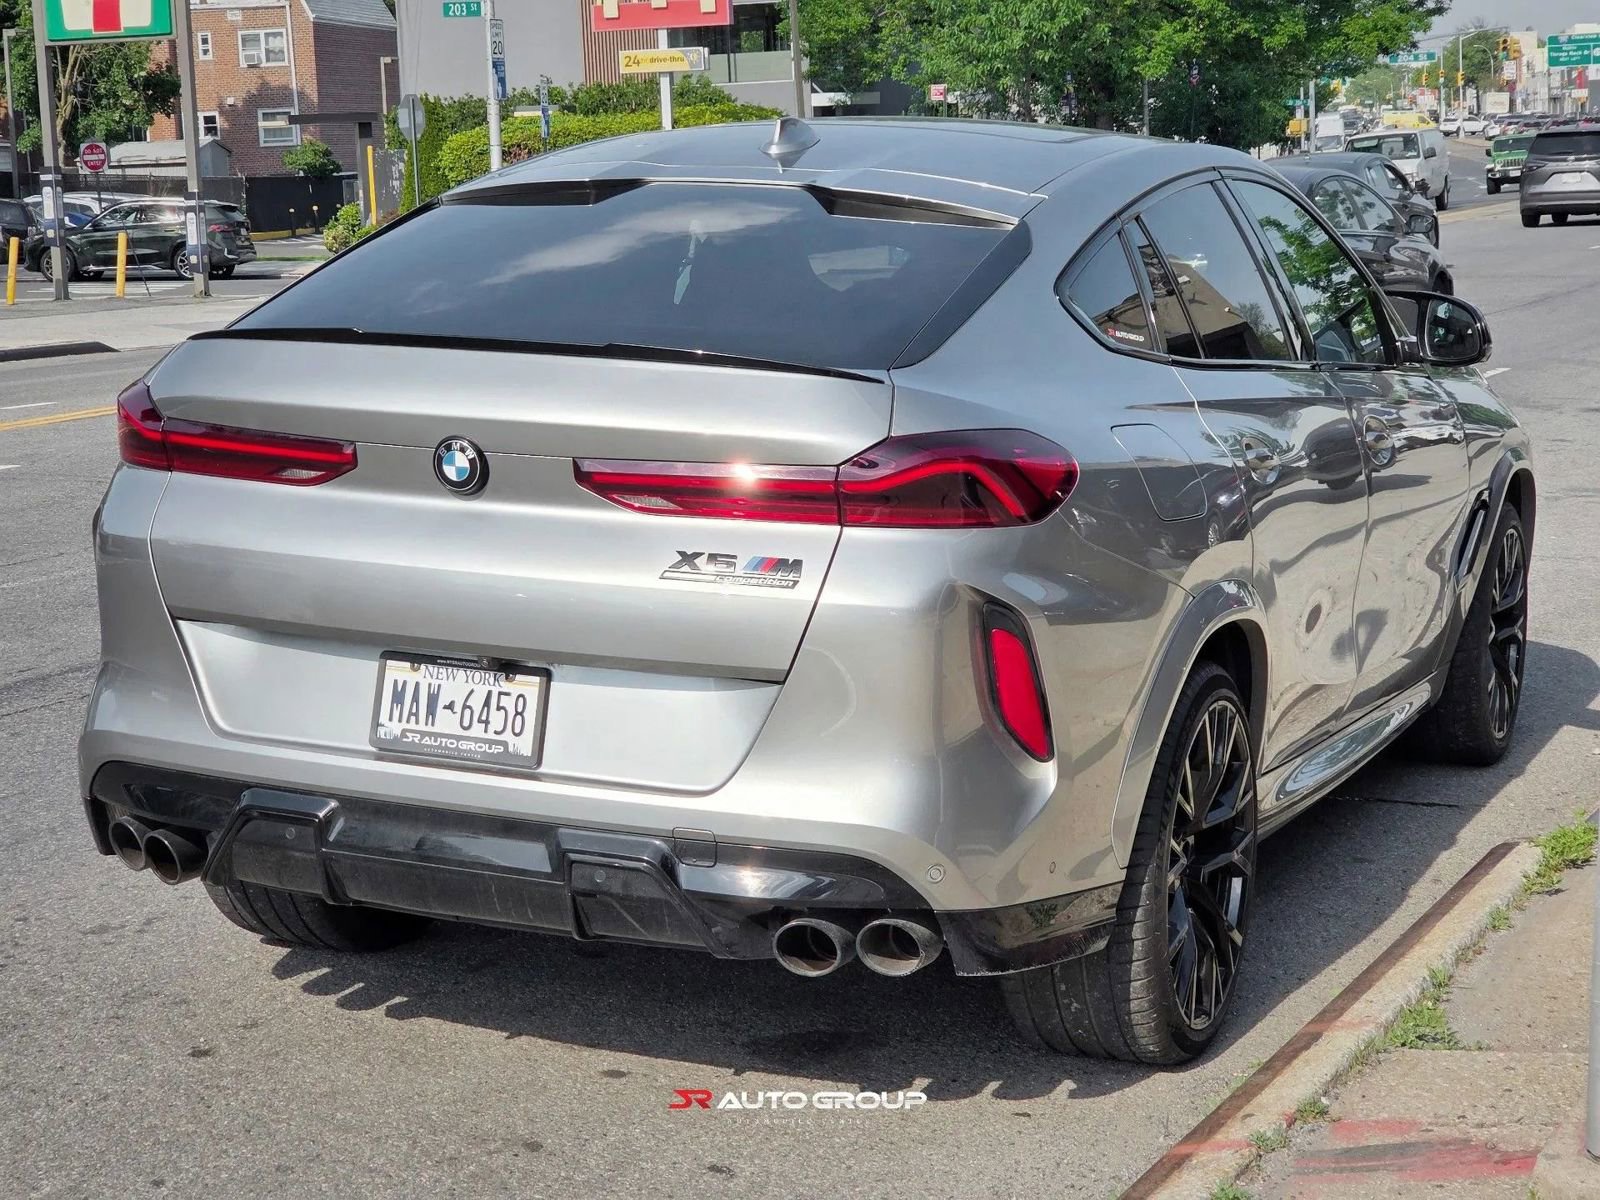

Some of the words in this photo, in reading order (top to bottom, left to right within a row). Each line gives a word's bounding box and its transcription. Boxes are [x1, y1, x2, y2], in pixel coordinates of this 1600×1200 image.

[448, 3, 467, 16] 203
[470, 3, 477, 11] St
[492, 40, 503, 55] 20
[649, 54, 685, 64] drive-thru
[439, 442, 476, 460] BMW
[668, 550, 738, 573] X6
[423, 664, 461, 682] NEW
[463, 668, 505, 688] YORK
[388, 678, 442, 727] MAW
[459, 688, 528, 738] 6458
[420, 735, 458, 748] AUTO
[458, 740, 505, 754] GROUP
